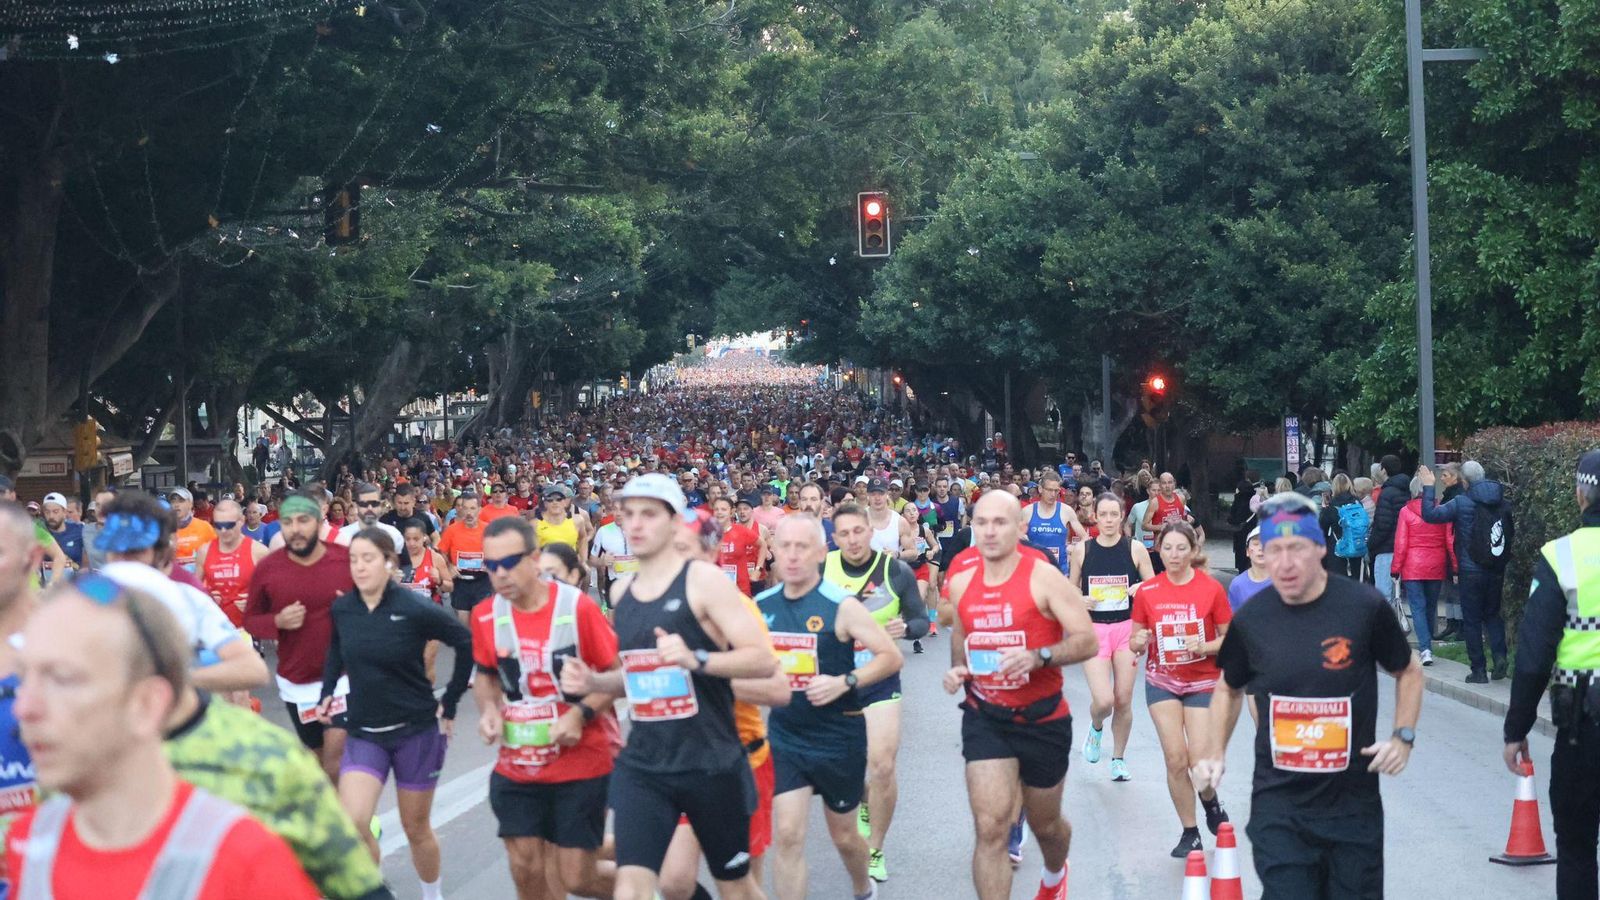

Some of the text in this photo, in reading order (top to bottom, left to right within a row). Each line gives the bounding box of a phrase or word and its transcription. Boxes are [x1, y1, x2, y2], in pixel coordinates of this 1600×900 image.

[1286, 417, 1298, 427] BUS
[1290, 703, 1344, 714] GENERALI
[1296, 724, 1324, 739] 246
